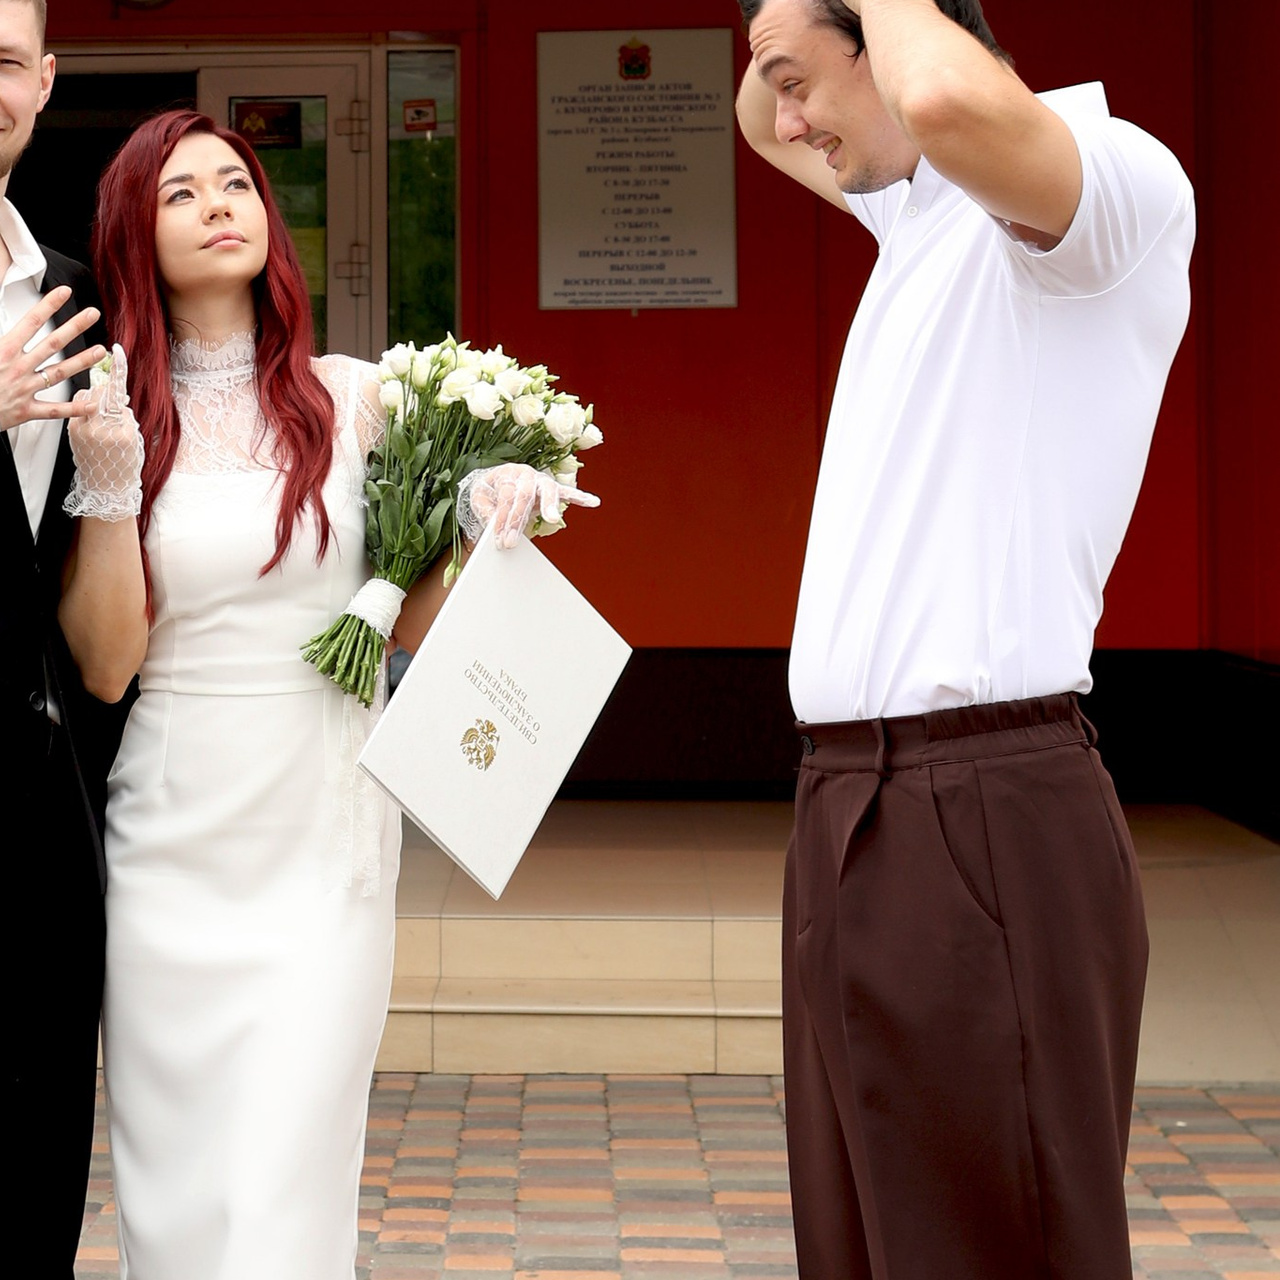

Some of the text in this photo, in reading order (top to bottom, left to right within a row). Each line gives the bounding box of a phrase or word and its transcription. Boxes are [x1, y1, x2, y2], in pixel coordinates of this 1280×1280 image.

[633, 104, 716, 113] КЕМЕРОВСКОГО
[632, 179, 646, 187] ДО
[610, 263, 665, 271] ВЫХОДНОЙ
[638, 277, 713, 285] ПОНЕДЕЛЬНИК
[498, 668, 528, 701] БРАКА
[472, 659, 540, 731] О ЗАКЛЮЧЕНИИ
[464, 668, 537, 744] СВИДЕТЕЛЬСТВО
